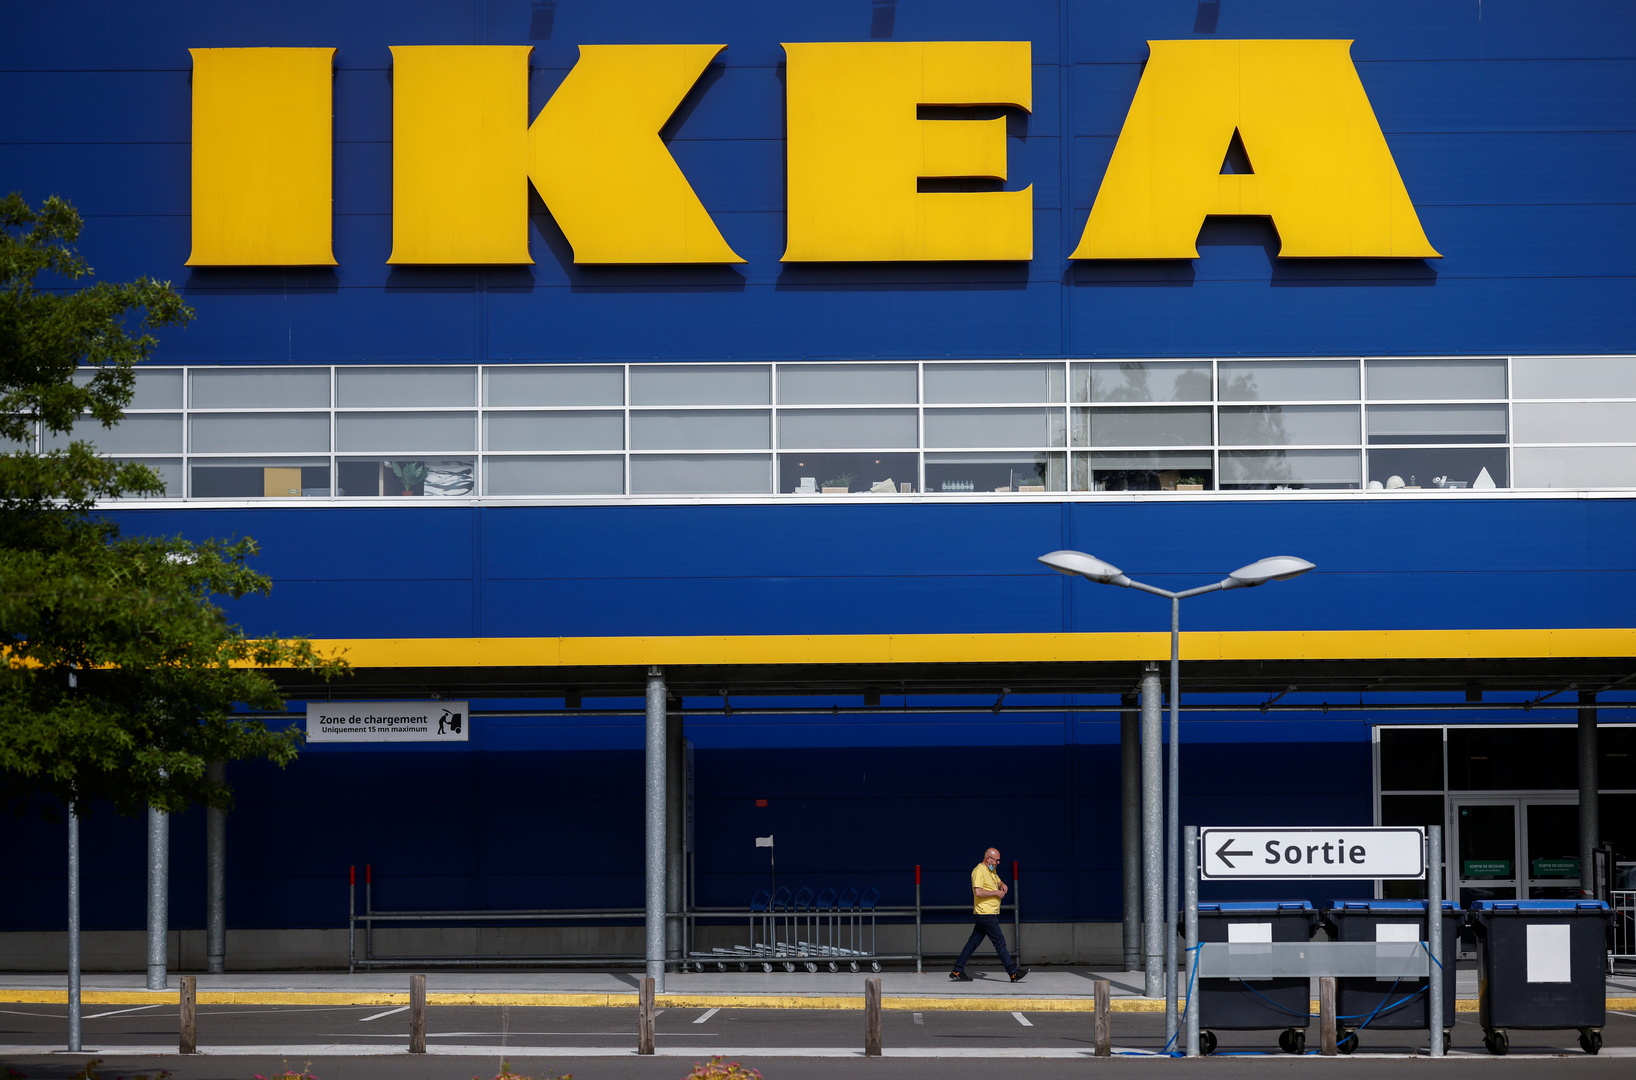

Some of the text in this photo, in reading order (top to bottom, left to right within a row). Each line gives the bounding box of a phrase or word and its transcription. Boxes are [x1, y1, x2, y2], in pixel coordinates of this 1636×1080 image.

[185, 39, 1444, 267] IKEA
[319, 714, 428, 727] Zone de chargement
[321, 726, 367, 734] Uniquement
[1265, 838, 1366, 865] Sortie
